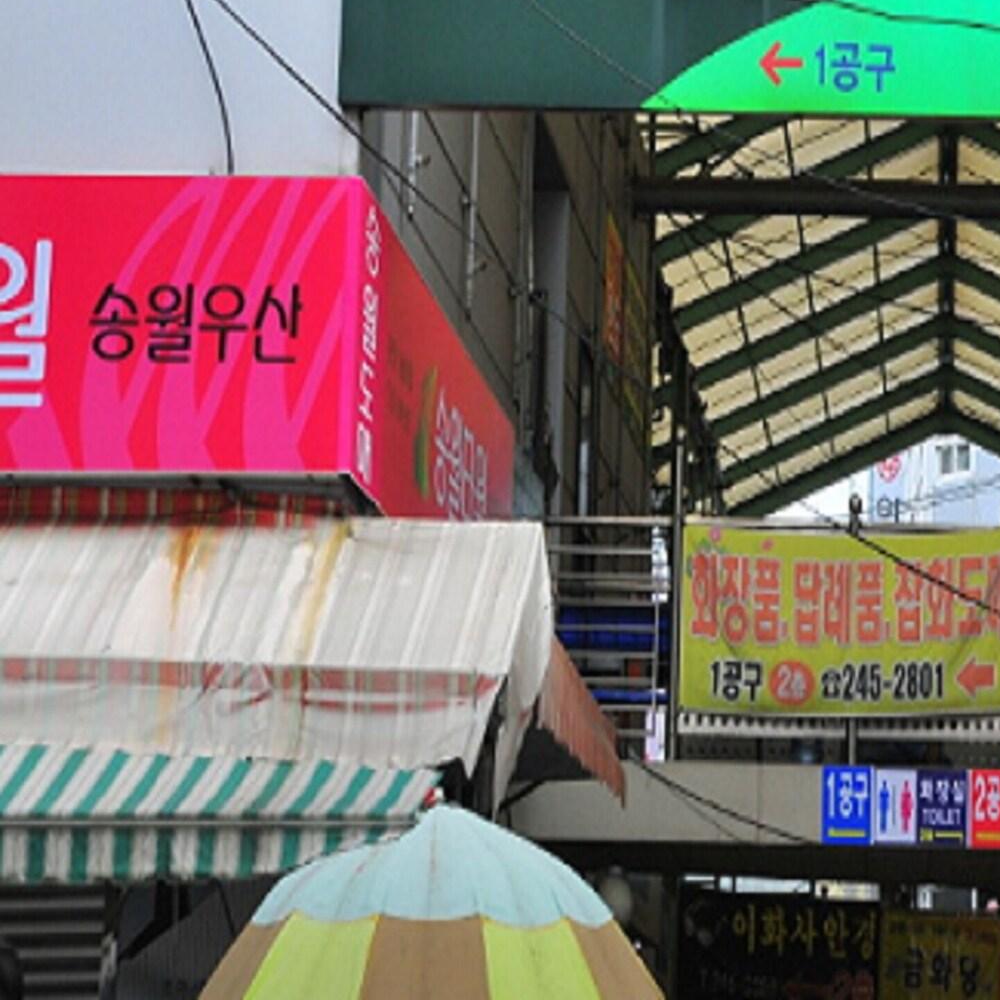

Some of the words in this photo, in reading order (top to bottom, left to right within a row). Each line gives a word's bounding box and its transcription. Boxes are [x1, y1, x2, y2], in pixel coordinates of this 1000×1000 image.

[814, 43, 897, 94] 1공구
[89, 282, 304, 364] 송월우산
[711, 660, 763, 702] 1공구
[827, 771, 868, 820] 1공구
[921, 807, 962, 827] TOILET
